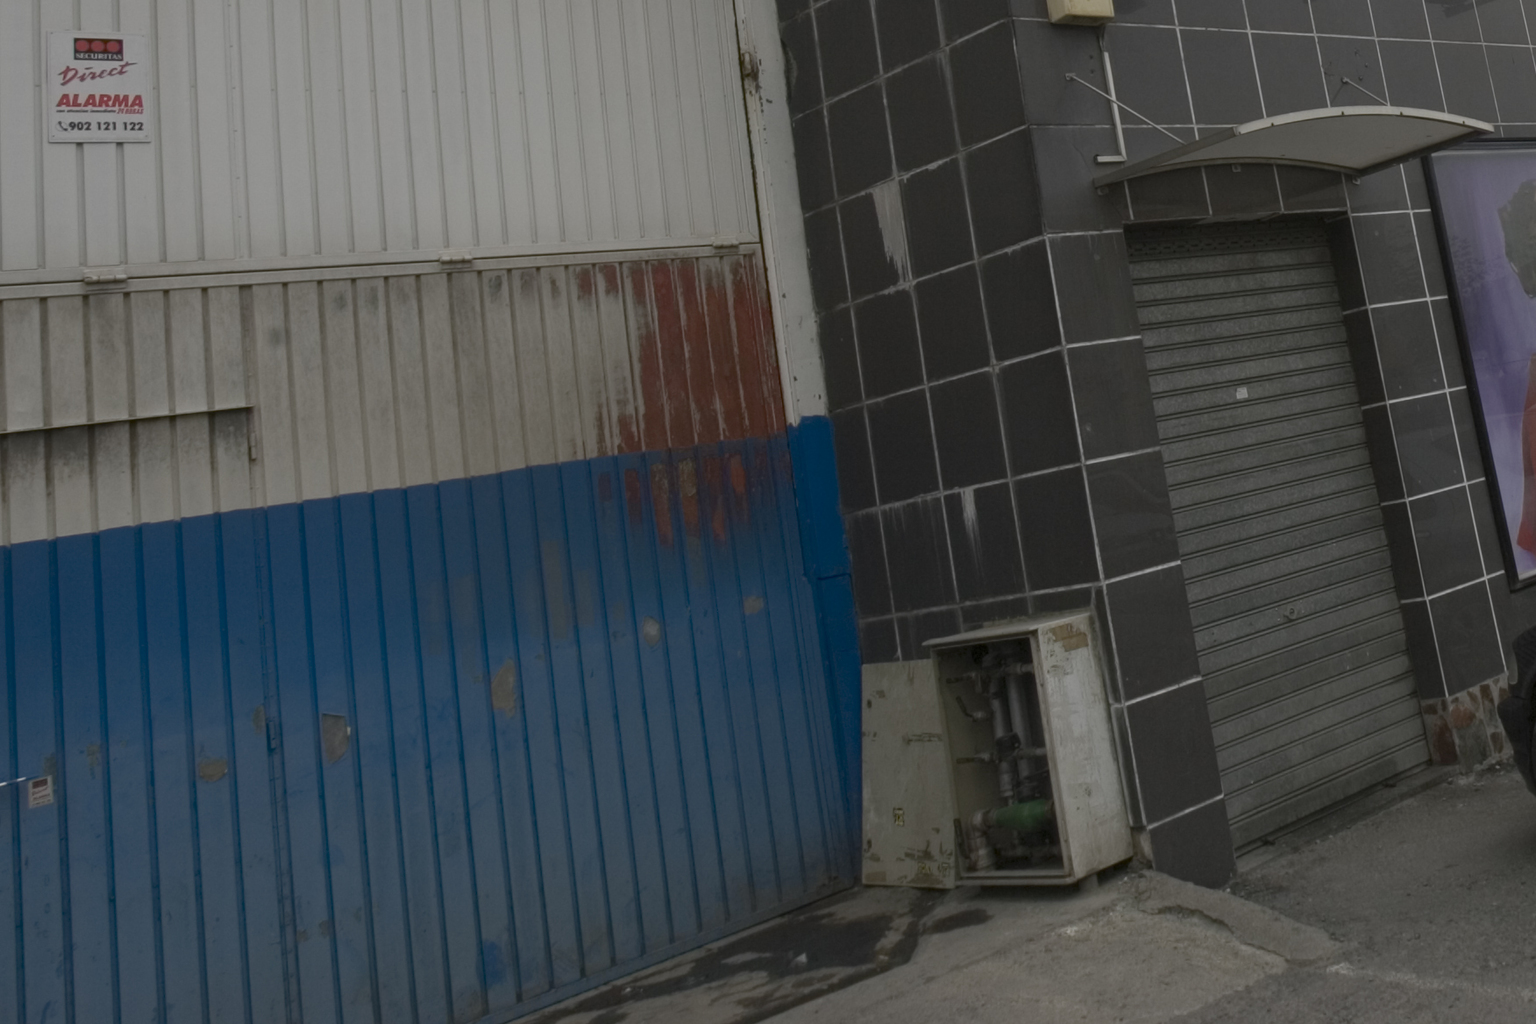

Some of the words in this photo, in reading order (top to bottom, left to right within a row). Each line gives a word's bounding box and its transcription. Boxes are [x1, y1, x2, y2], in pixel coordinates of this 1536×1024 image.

[75, 52, 122, 60] SECURITAS
[58, 61, 138, 86] Direct
[56, 94, 144, 107] ALARMA
[68, 121, 91, 131] 902
[96, 121, 116, 131] 121
[123, 121, 144, 131] 122
